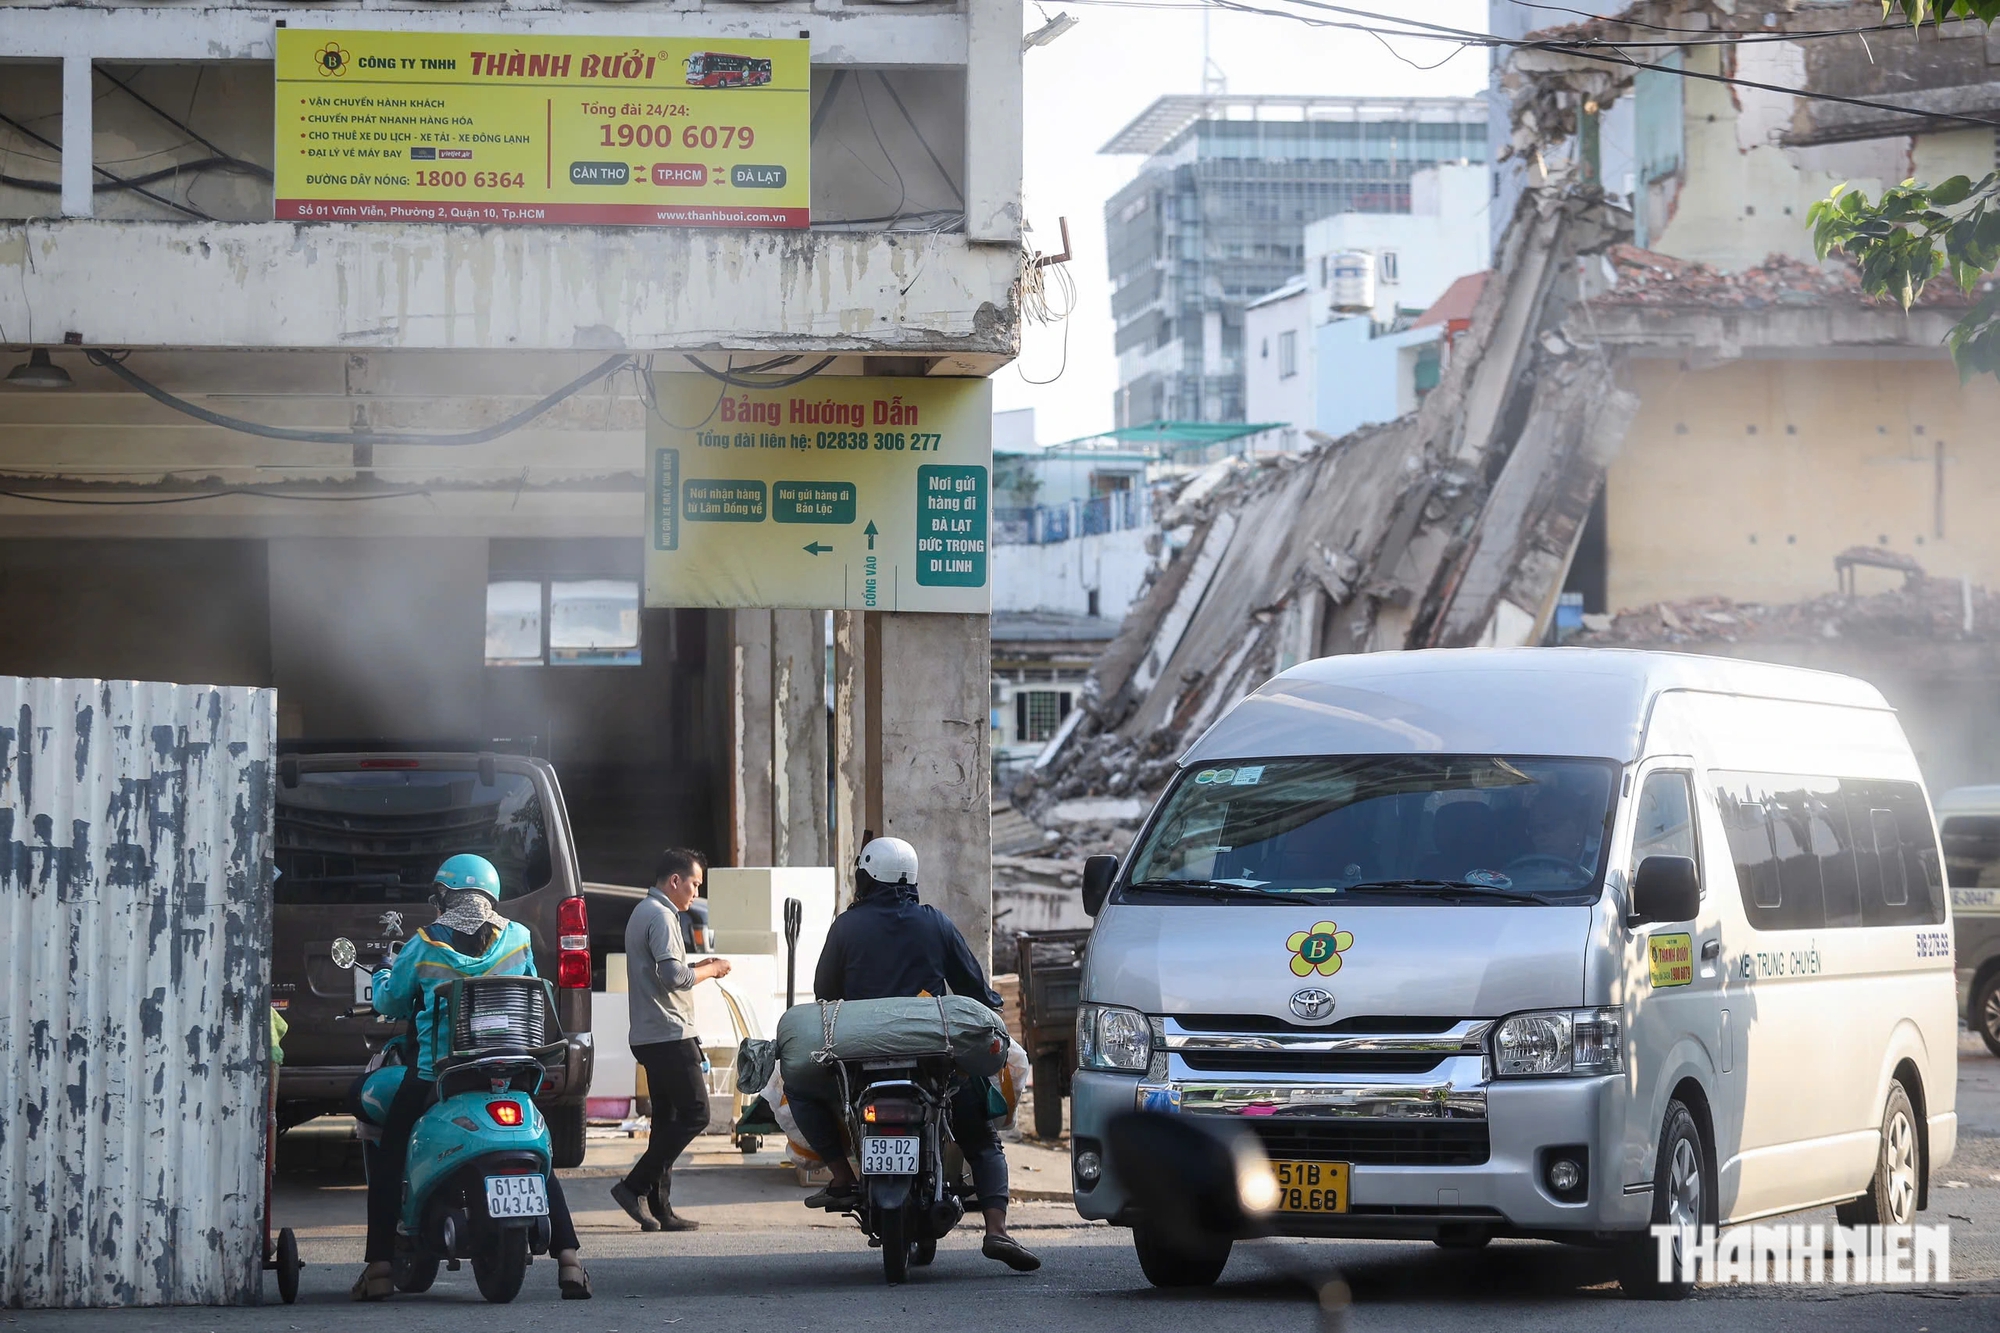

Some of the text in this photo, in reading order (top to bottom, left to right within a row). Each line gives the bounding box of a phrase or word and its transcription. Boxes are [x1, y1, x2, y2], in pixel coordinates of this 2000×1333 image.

[358, 56, 456, 69] CÔNG TY TNHH
[470, 49, 656, 79] THÀNH BƯỞI
[309, 96, 445, 108] VẬN CHUYỂN HÀNH KHÁCH
[581, 101, 690, 118] Tổng đài 24/24:
[308, 113, 474, 125] CHUYỂN PHÁT NHANH HÀNG HÓA
[308, 131, 329, 140] CHO
[332, 130, 357, 140] THUÊ
[359, 132, 371, 140] XE
[373, 133, 388, 141] DU
[390, 133, 411, 143] LỊCH
[420, 133, 432, 141] XE
[434, 131, 450, 142] TẢI
[458, 133, 470, 142] XE
[472, 132, 501, 143] ĐÔNG
[503, 135, 530, 145] LẠNH
[600, 124, 755, 149] 1900 6079
[308, 147, 402, 158] ĐẠI LÝ VÉ MÁY BAY
[306, 170, 525, 188] ĐƯỜNG DÂY NÓNG: 1800 6364
[573, 167, 626, 179] CẦN THƠ
[658, 169, 702, 181] TP.HCM
[736, 169, 781, 184] ĐÀ LẠT
[298, 204, 545, 220] Số 01 Vĩnh Viễn, Phường 2, Quận 10, Tp.HCM
[657, 209, 787, 223] www.thanhbuoi.com.vn
[721, 394, 918, 428] Bảng Hướng Dẫn
[696, 429, 942, 452] Tổng đài liên hệ: 02838 306 277
[929, 475, 976, 492] Nơi gửi
[690, 488, 761, 501] Nơi nhận hàng
[779, 488, 849, 501] Nơi gửi hàng đi
[688, 501, 763, 515] từ Lâm Đồng về
[796, 502, 833, 516] Bảo Lộc
[928, 495, 976, 511] hàng đi
[931, 516, 972, 534] ĐÀ LẠT
[918, 537, 985, 555] ĐỨC TRỌNG
[930, 559, 973, 573] DI LINH
[861, 556, 877, 607] CỔNG VÀO
[1738, 937, 1821, 979] XE TRUNG CHUYỂN
[871, 1139, 911, 1155] 59-D2
[866, 1156, 915, 1172] 339.12
[1278, 1163, 1320, 1186] 51B
[495, 1178, 536, 1196] 61-CA
[491, 1195, 545, 1215] 043.43
[1278, 1187, 1337, 1211] 78.68
